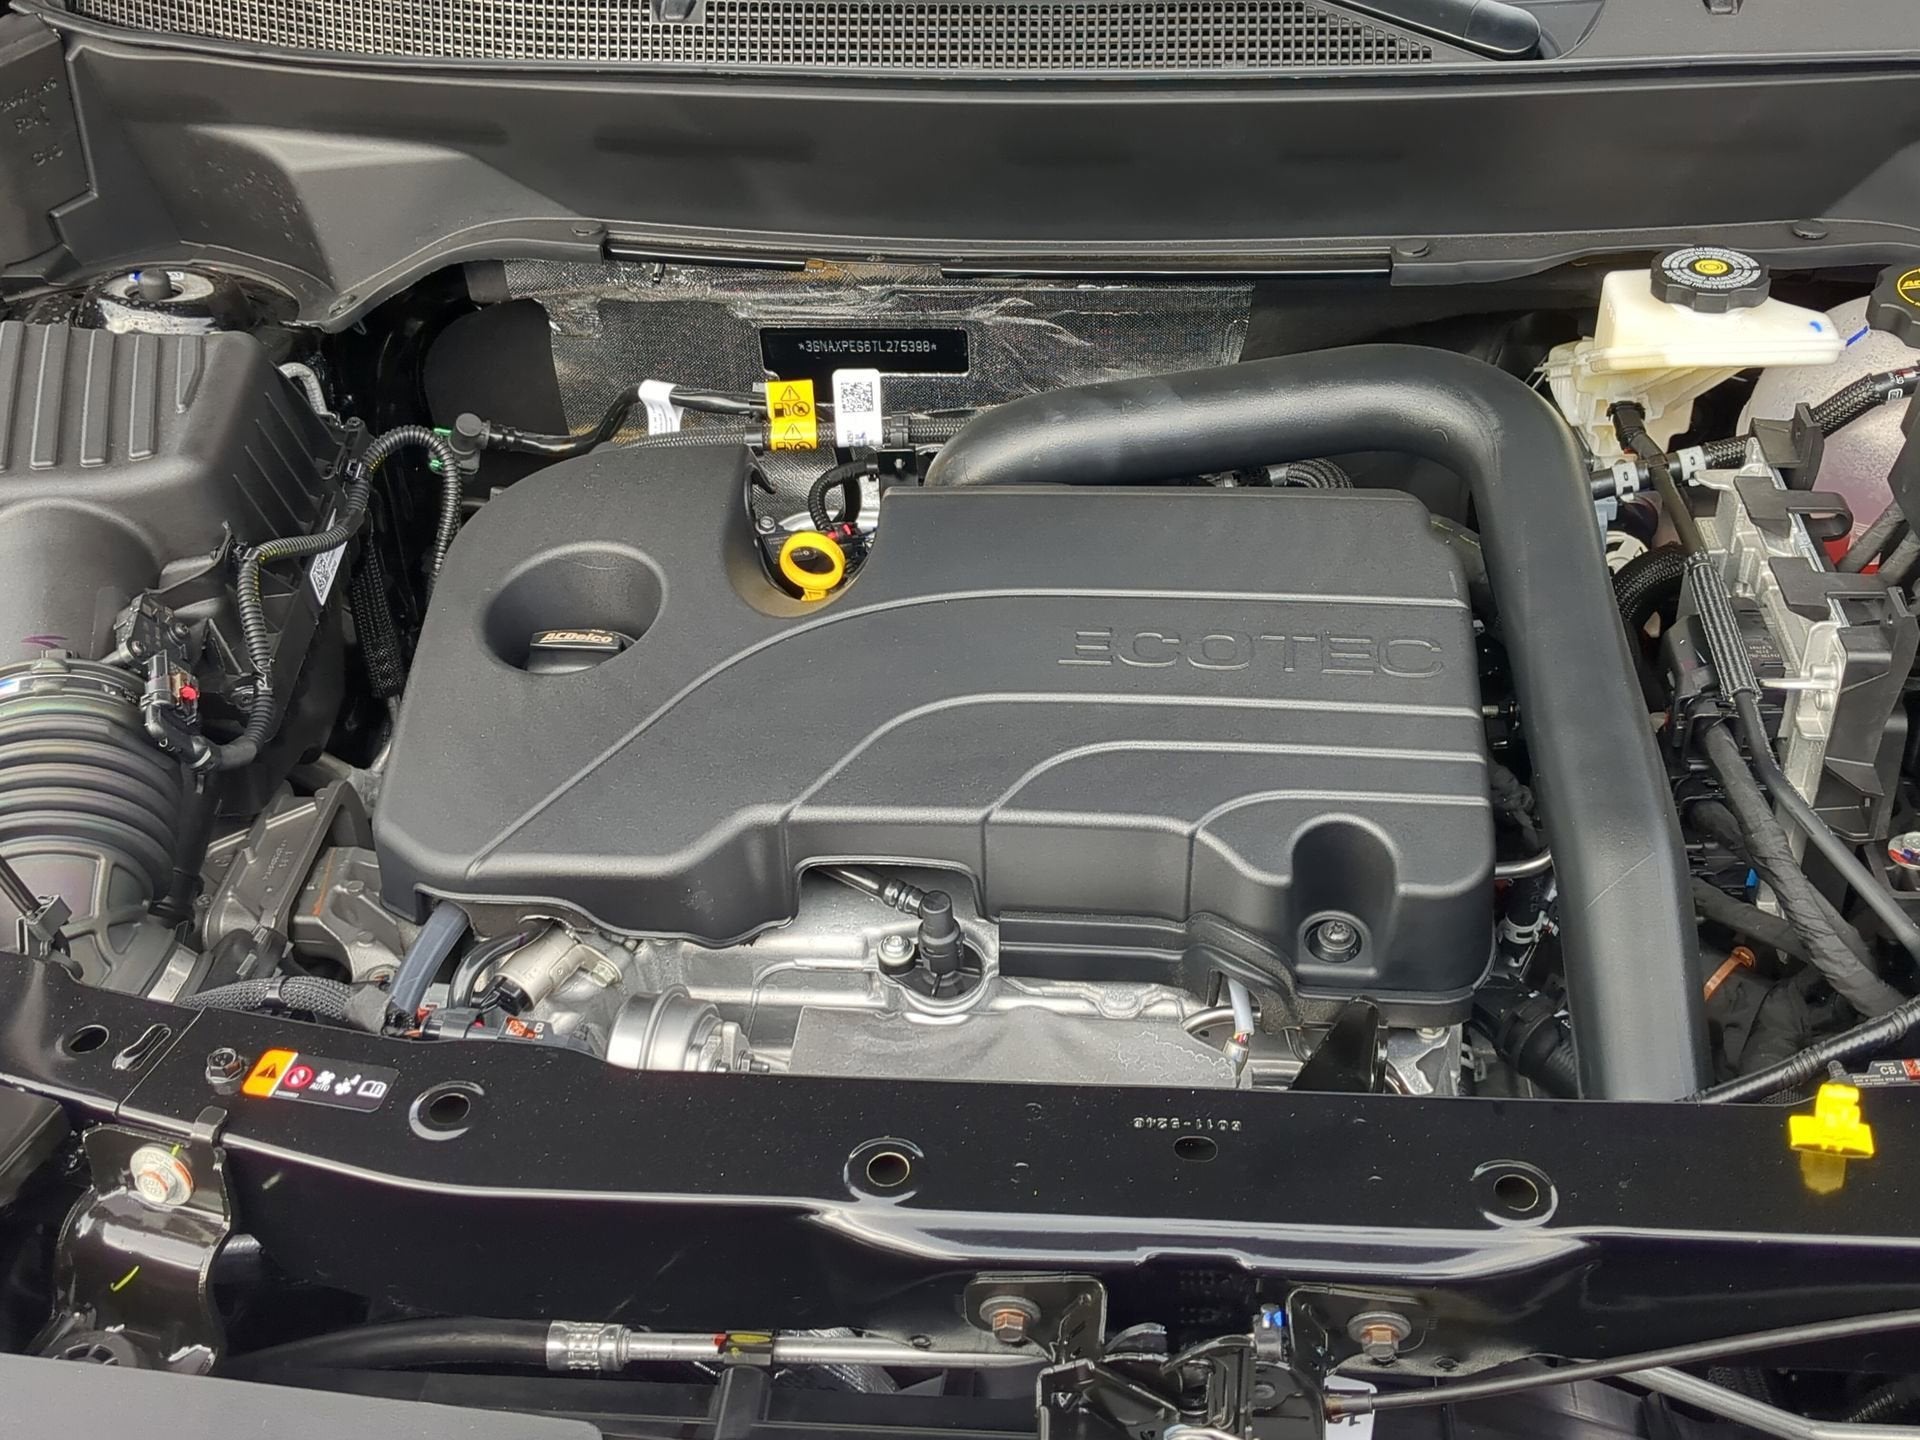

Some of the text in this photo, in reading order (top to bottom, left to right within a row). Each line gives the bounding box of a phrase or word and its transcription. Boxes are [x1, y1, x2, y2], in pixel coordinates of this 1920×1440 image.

[540, 632, 613, 644] ACDelco
[1056, 627, 1445, 679] ECOTEC
[309, 1082, 331, 1092] AUTO
